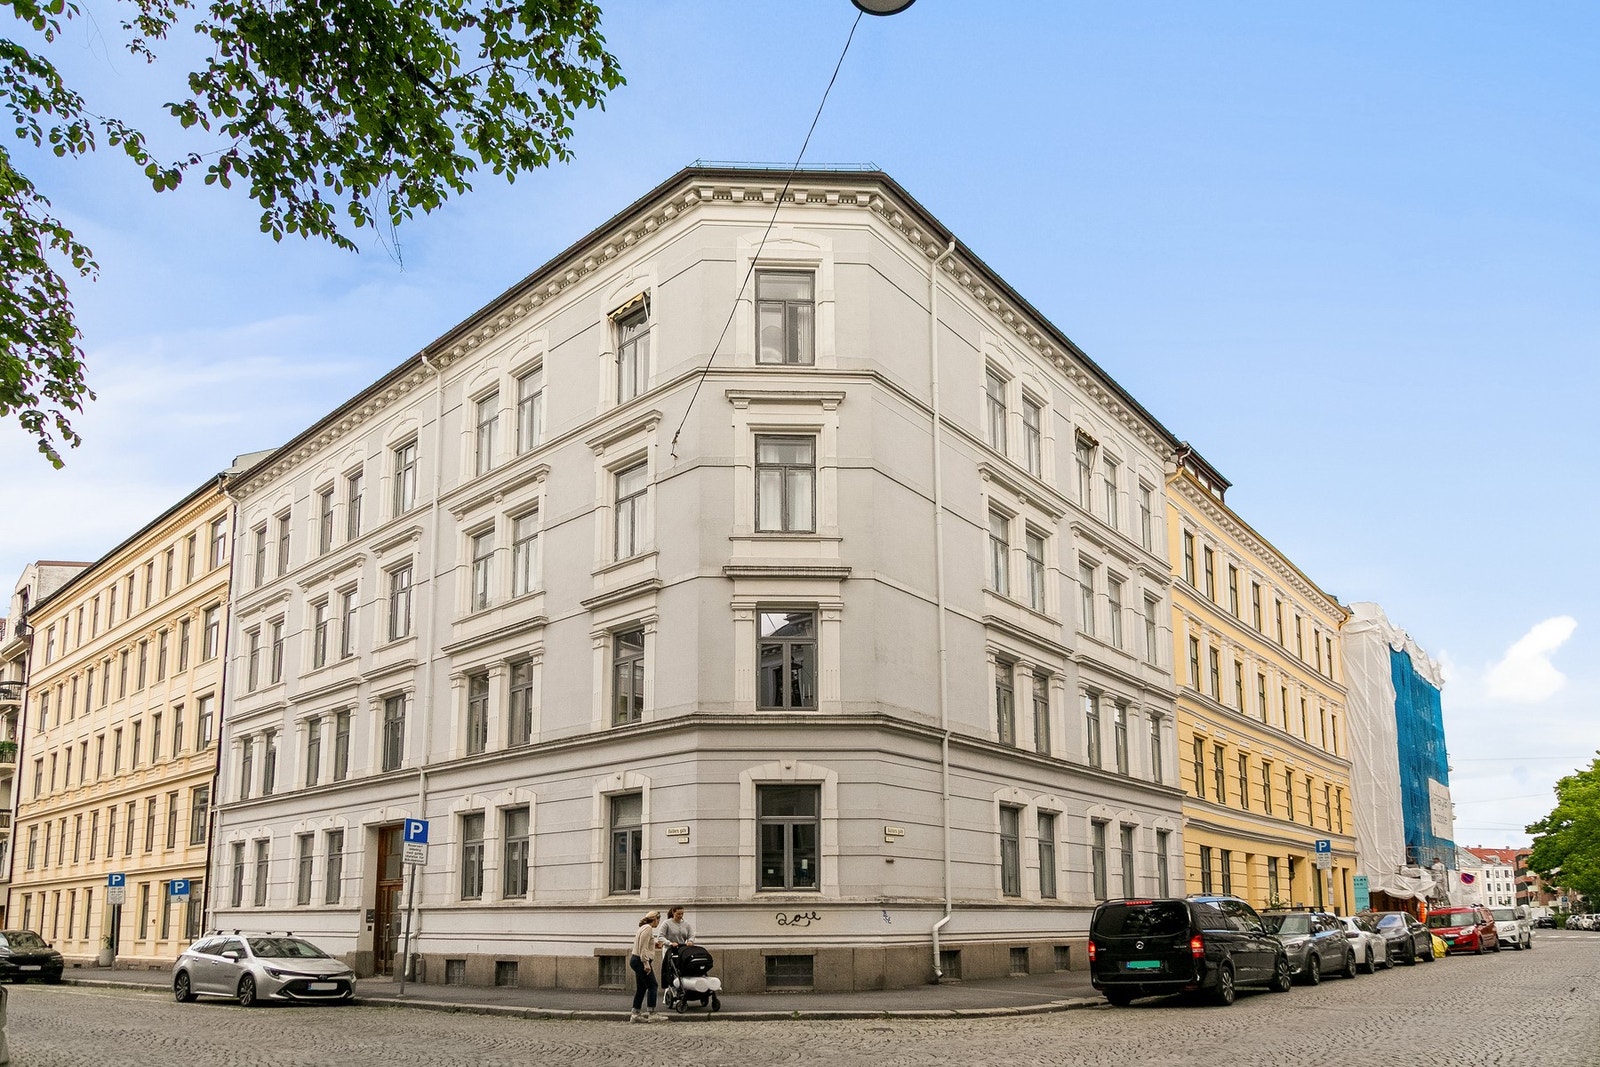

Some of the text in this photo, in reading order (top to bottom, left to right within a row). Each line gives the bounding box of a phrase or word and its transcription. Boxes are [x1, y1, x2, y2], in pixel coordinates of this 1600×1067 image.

[410, 821, 423, 840] P
[1319, 841, 1327, 851] P
[112, 875, 121, 885] P
[175, 882, 184, 893] P
